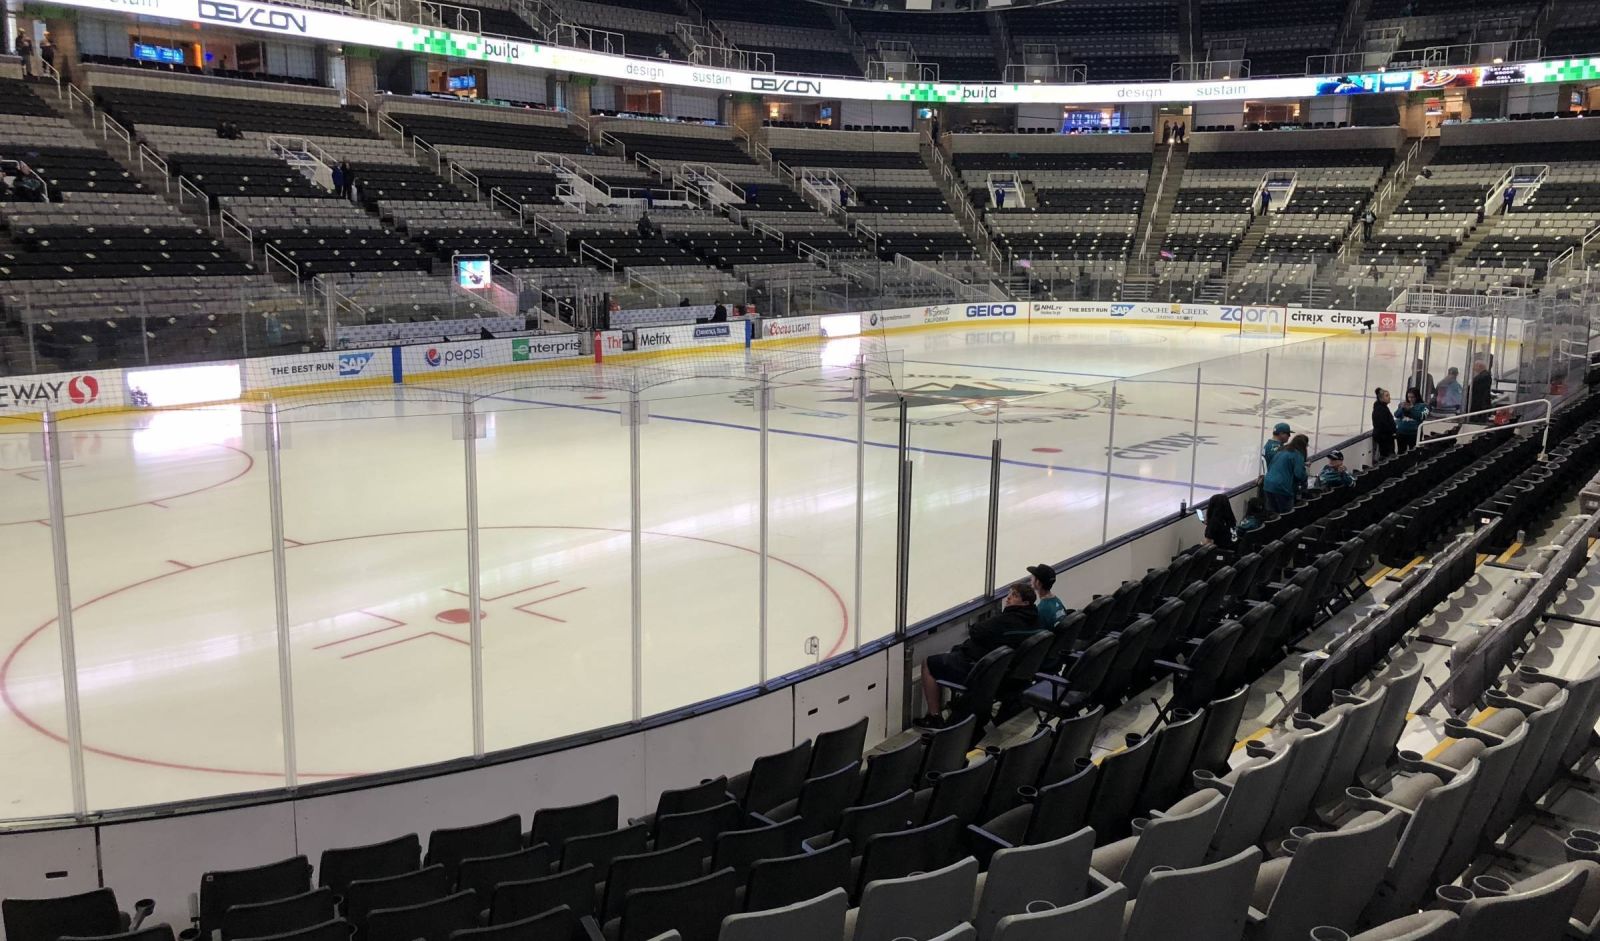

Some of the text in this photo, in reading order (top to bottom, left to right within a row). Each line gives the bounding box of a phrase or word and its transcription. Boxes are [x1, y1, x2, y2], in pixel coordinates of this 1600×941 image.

[198, 1, 307, 33] DEVCON
[484, 40, 519, 59] build
[626, 62, 664, 80] design
[692, 71, 731, 86] sustain
[751, 77, 821, 95] DEVCON
[963, 86, 997, 99] build
[1117, 87, 1162, 99] design
[1196, 85, 1247, 97] sustain
[966, 304, 1017, 318] GEICO
[1111, 305, 1131, 315] SAP
[1182, 308, 1208, 316] CREEK
[1220, 307, 1279, 323] zoom
[640, 333, 671, 346] Metrix
[445, 345, 484, 365] pepsi
[271, 355, 367, 375] THE BEST RUN SAP
